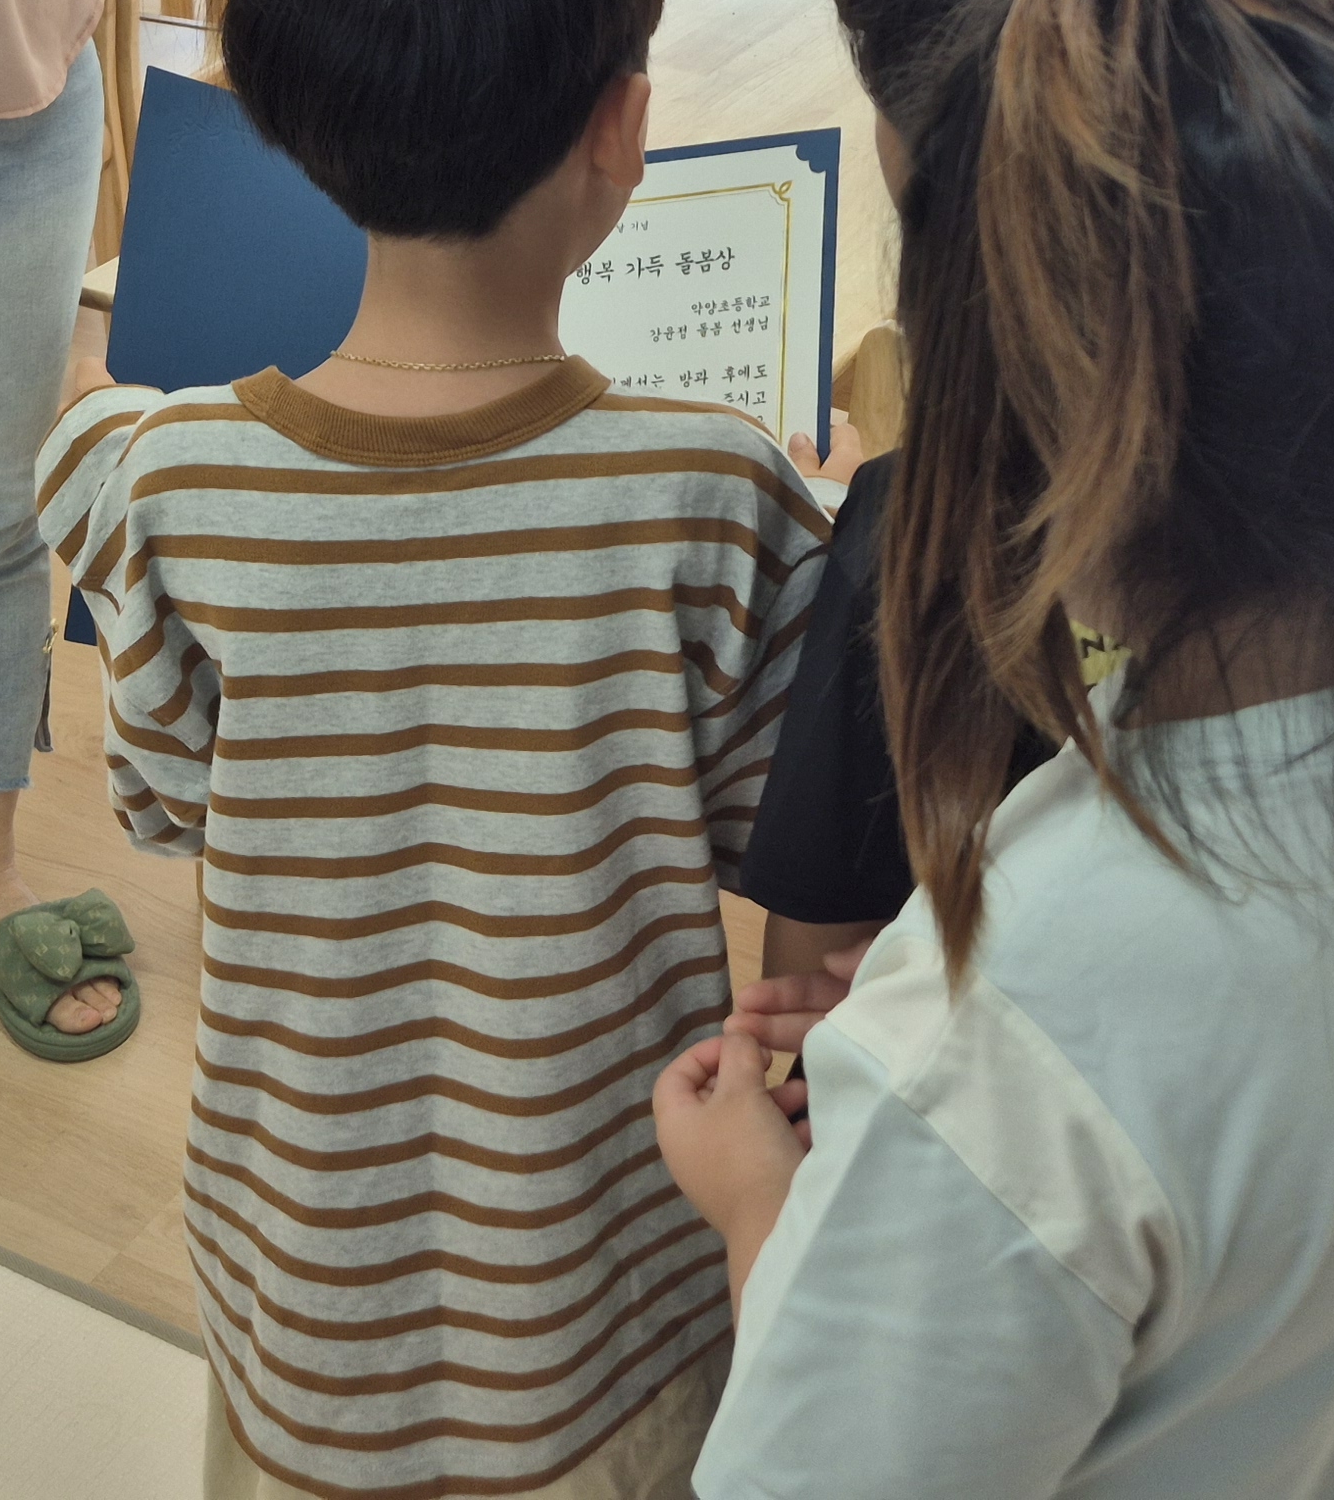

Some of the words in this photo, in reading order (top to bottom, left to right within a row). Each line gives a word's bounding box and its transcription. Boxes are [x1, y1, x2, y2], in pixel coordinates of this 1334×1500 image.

[576, 260, 614, 285] 행복
[626, 254, 664, 279] 가득
[675, 246, 736, 275] 돌봄상
[690, 295, 771, 316] 악양초등학교
[696, 320, 723, 338] 돌봄
[731, 315, 769, 334] 선생님
[679, 368, 709, 388] 방과
[721, 364, 768, 384] 후에도
